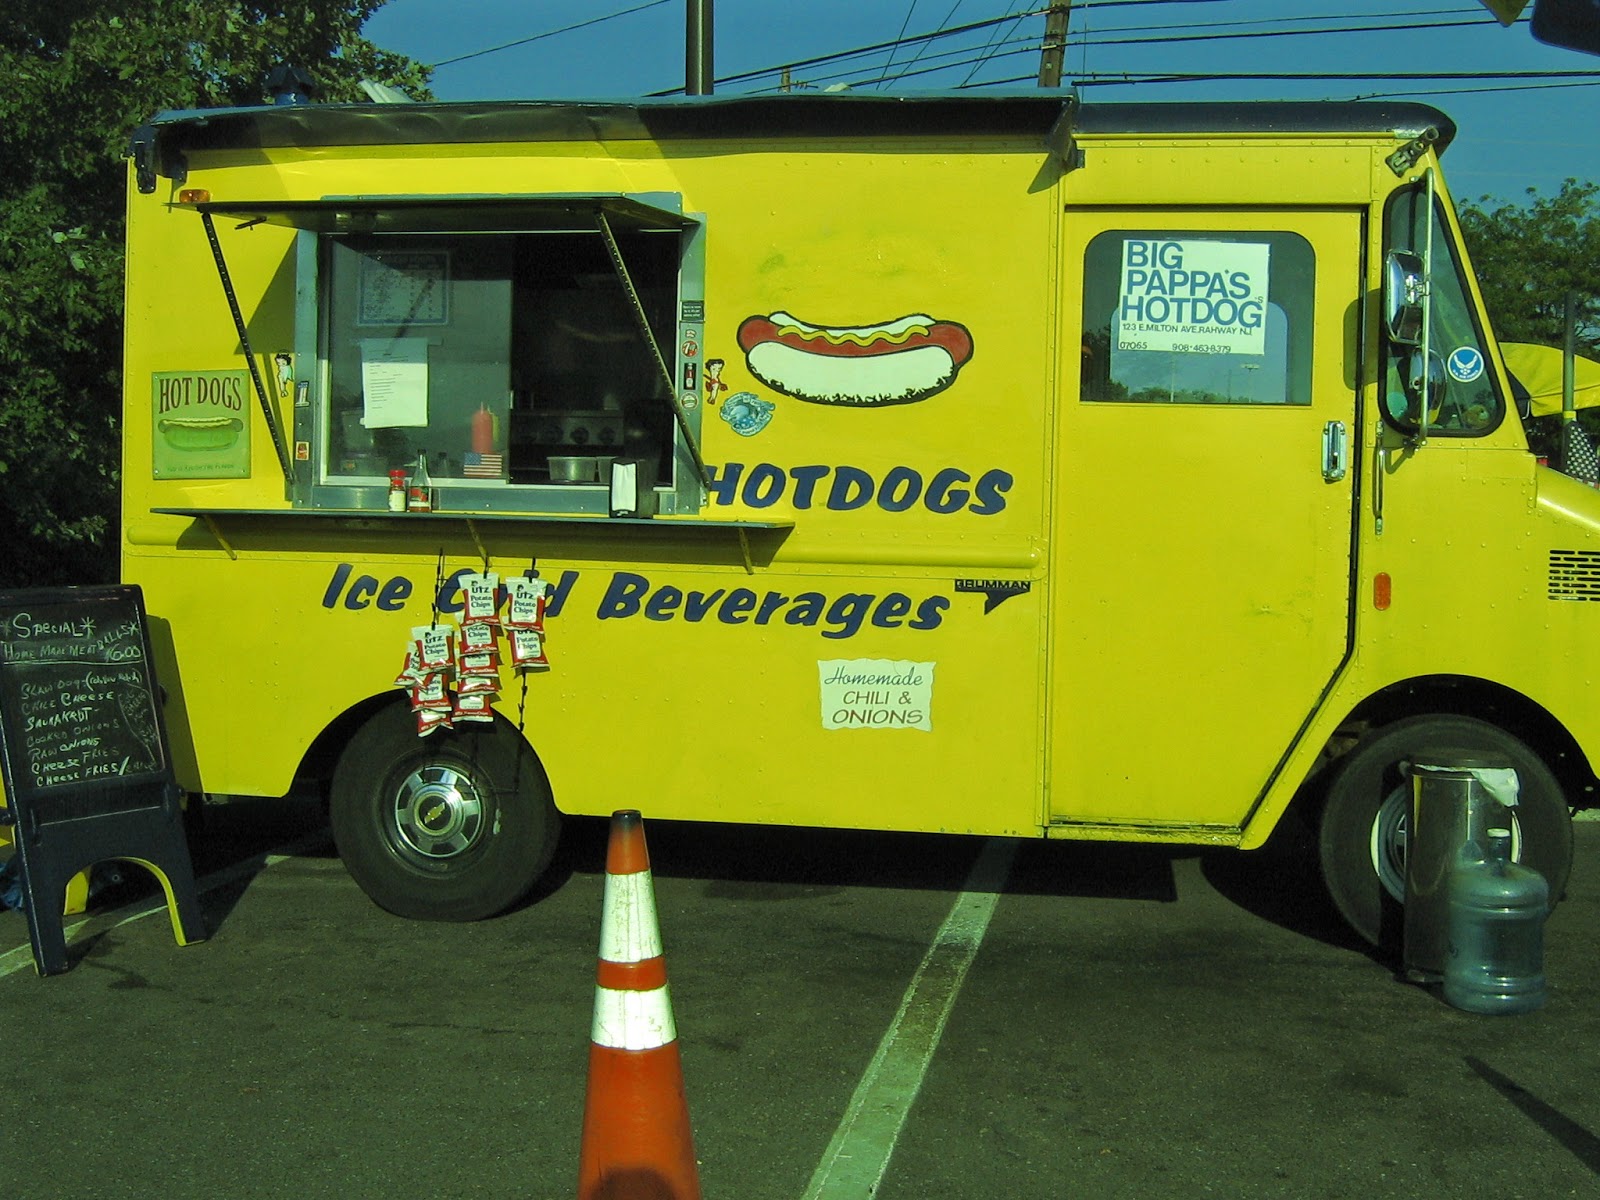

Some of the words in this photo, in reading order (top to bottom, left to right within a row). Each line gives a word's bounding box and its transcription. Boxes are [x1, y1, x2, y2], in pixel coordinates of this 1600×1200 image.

[1126, 241, 1184, 269] BIG
[1126, 269, 1251, 300] PAPPA'S
[1122, 323, 1137, 331] 123
[1119, 341, 1148, 350] 07065
[159, 377, 193, 414] HOT
[197, 376, 242, 411] DOGS
[706, 462, 1014, 516] HOTDOGS
[956, 580, 1030, 591] GRUMMAN
[323, 563, 413, 611] Ice
[596, 572, 950, 638] Beverages
[471, 601, 491, 609] Chips
[824, 665, 924, 686] Homemade
[843, 691, 890, 705] CHILI
[897, 691, 912, 705] &
[832, 709, 924, 725] ONIONS
